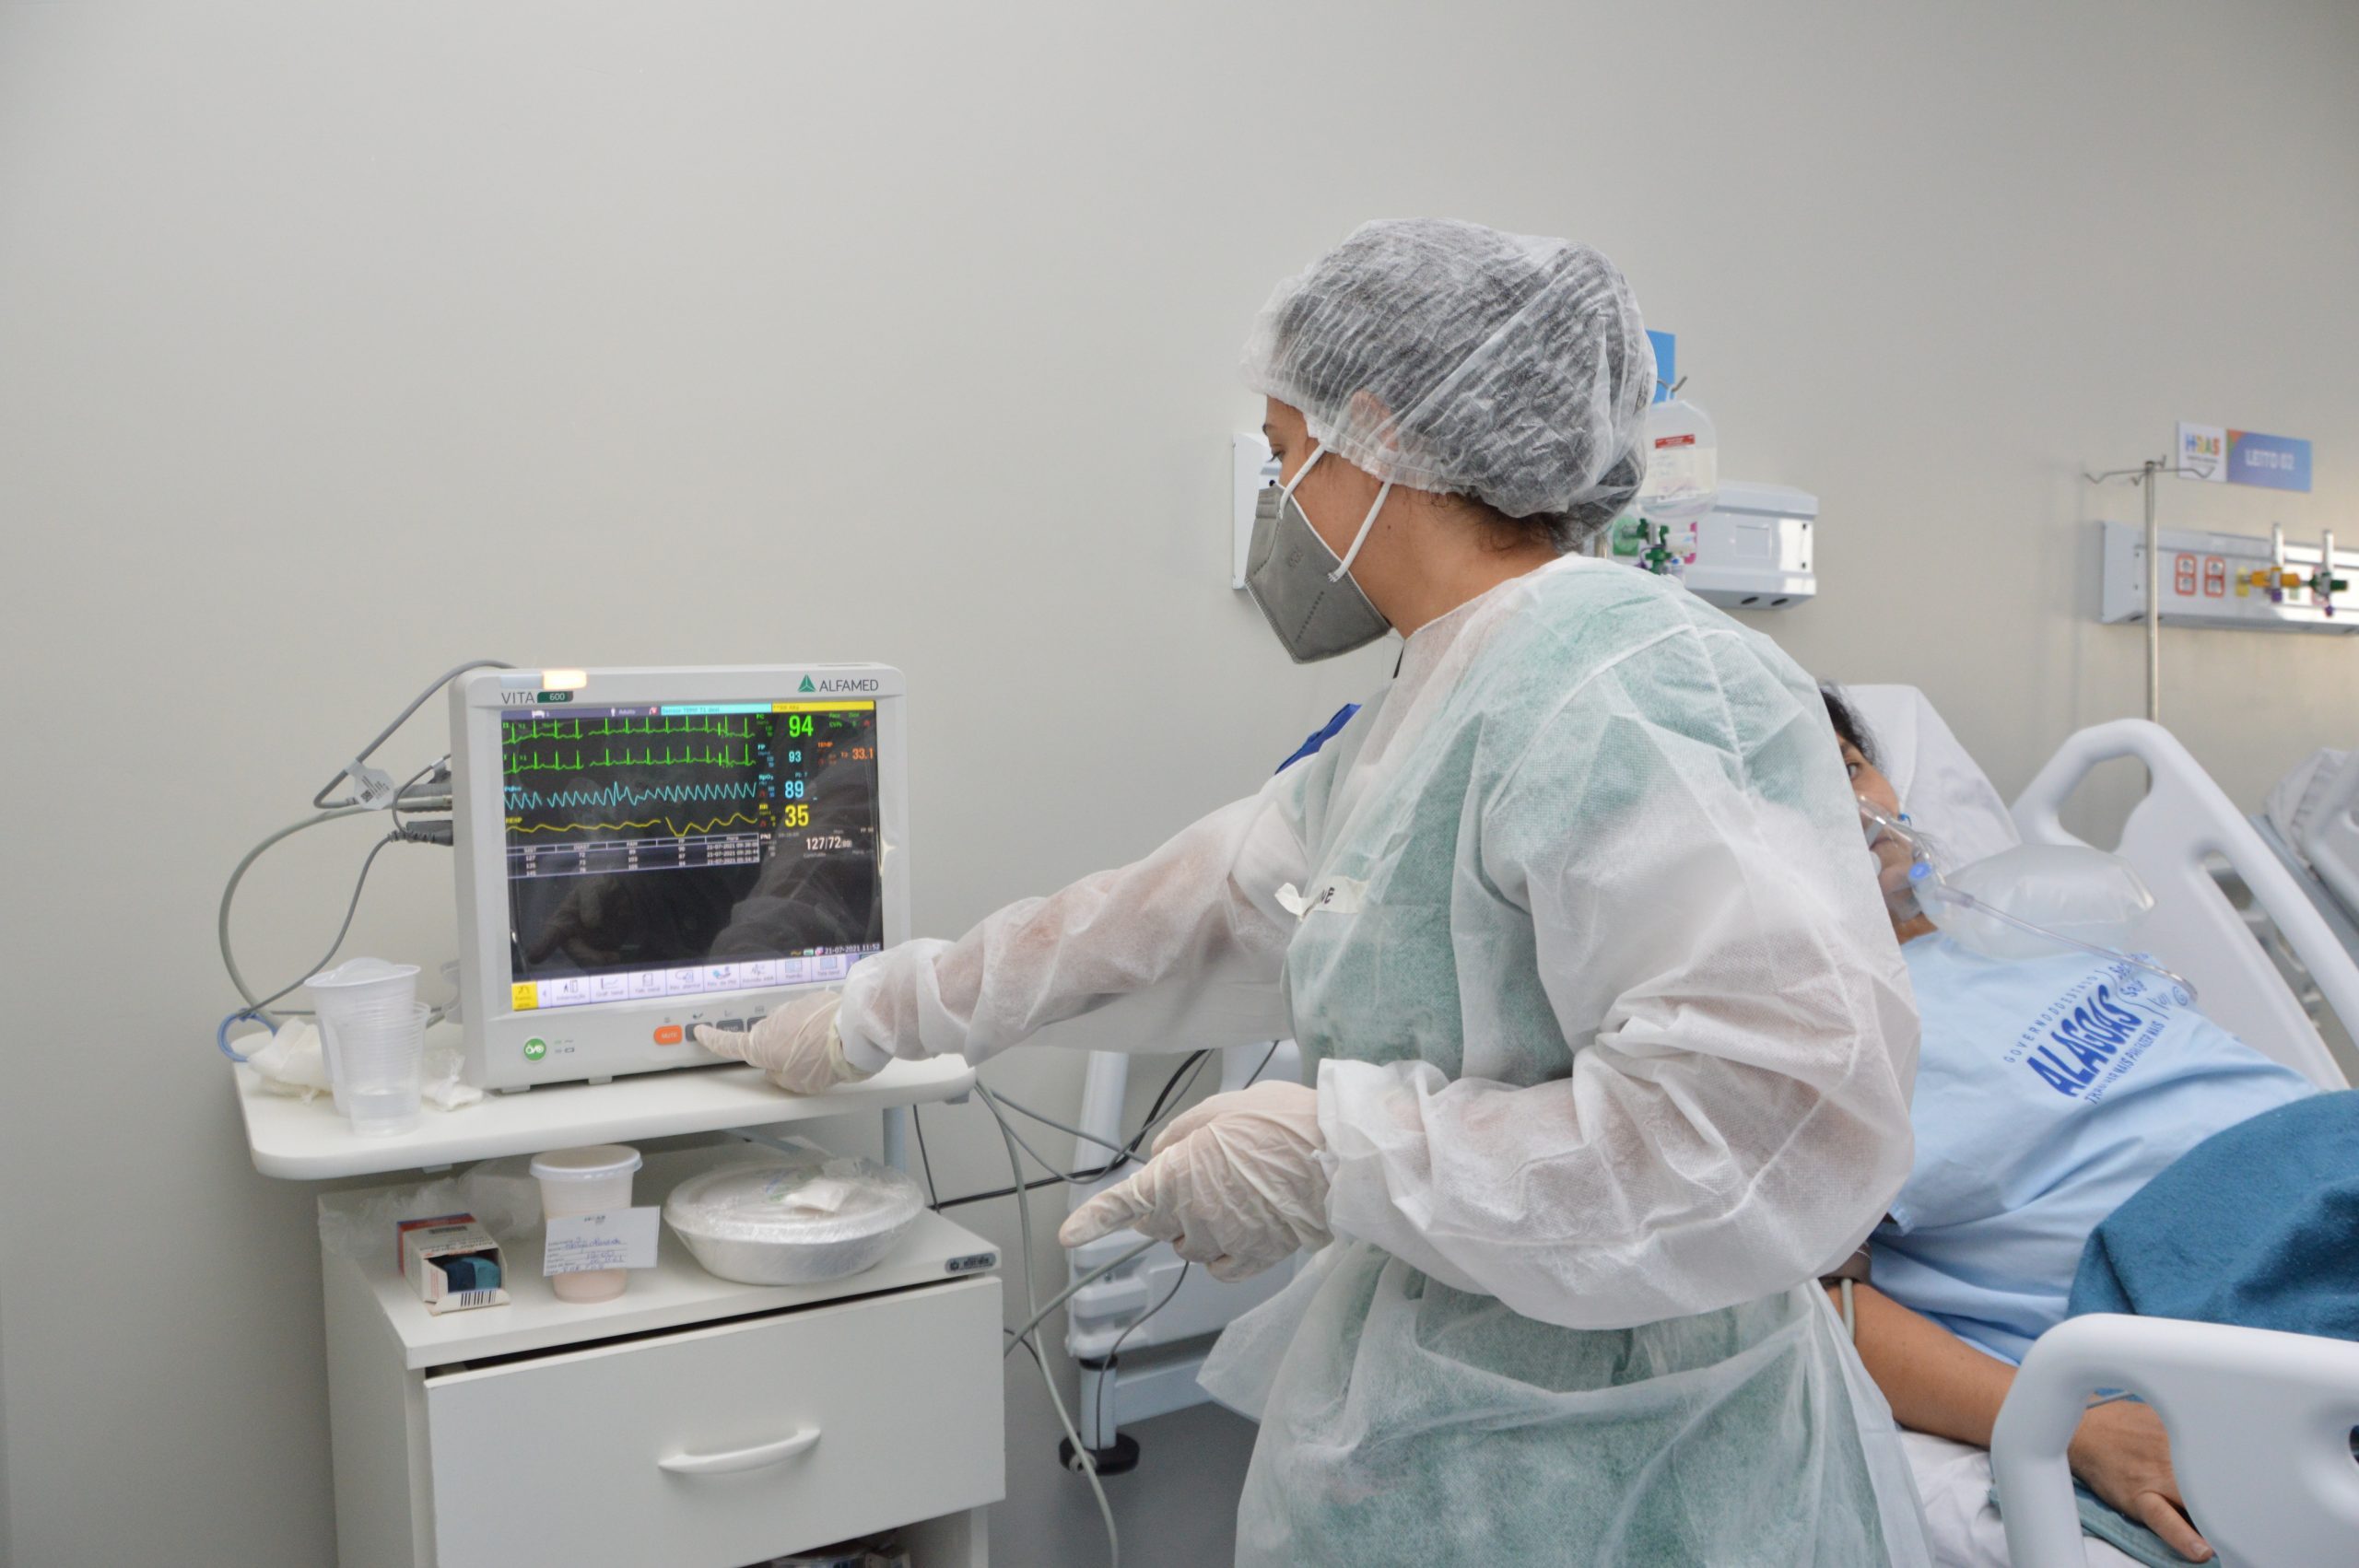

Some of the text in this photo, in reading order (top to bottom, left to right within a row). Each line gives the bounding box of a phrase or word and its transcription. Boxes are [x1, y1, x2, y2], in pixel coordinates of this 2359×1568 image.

[819, 680, 879, 692] ALFAMED
[501, 692, 566, 704] VITA 600
[789, 715, 814, 738] 94
[789, 750, 802, 763] 93
[852, 747, 874, 760] 33.1
[784, 780, 804, 799] 89
[784, 804, 809, 827] 35
[825, 944, 860, 954] 21-07-2021
[2026, 983, 2143, 1098] ALAGOAS
